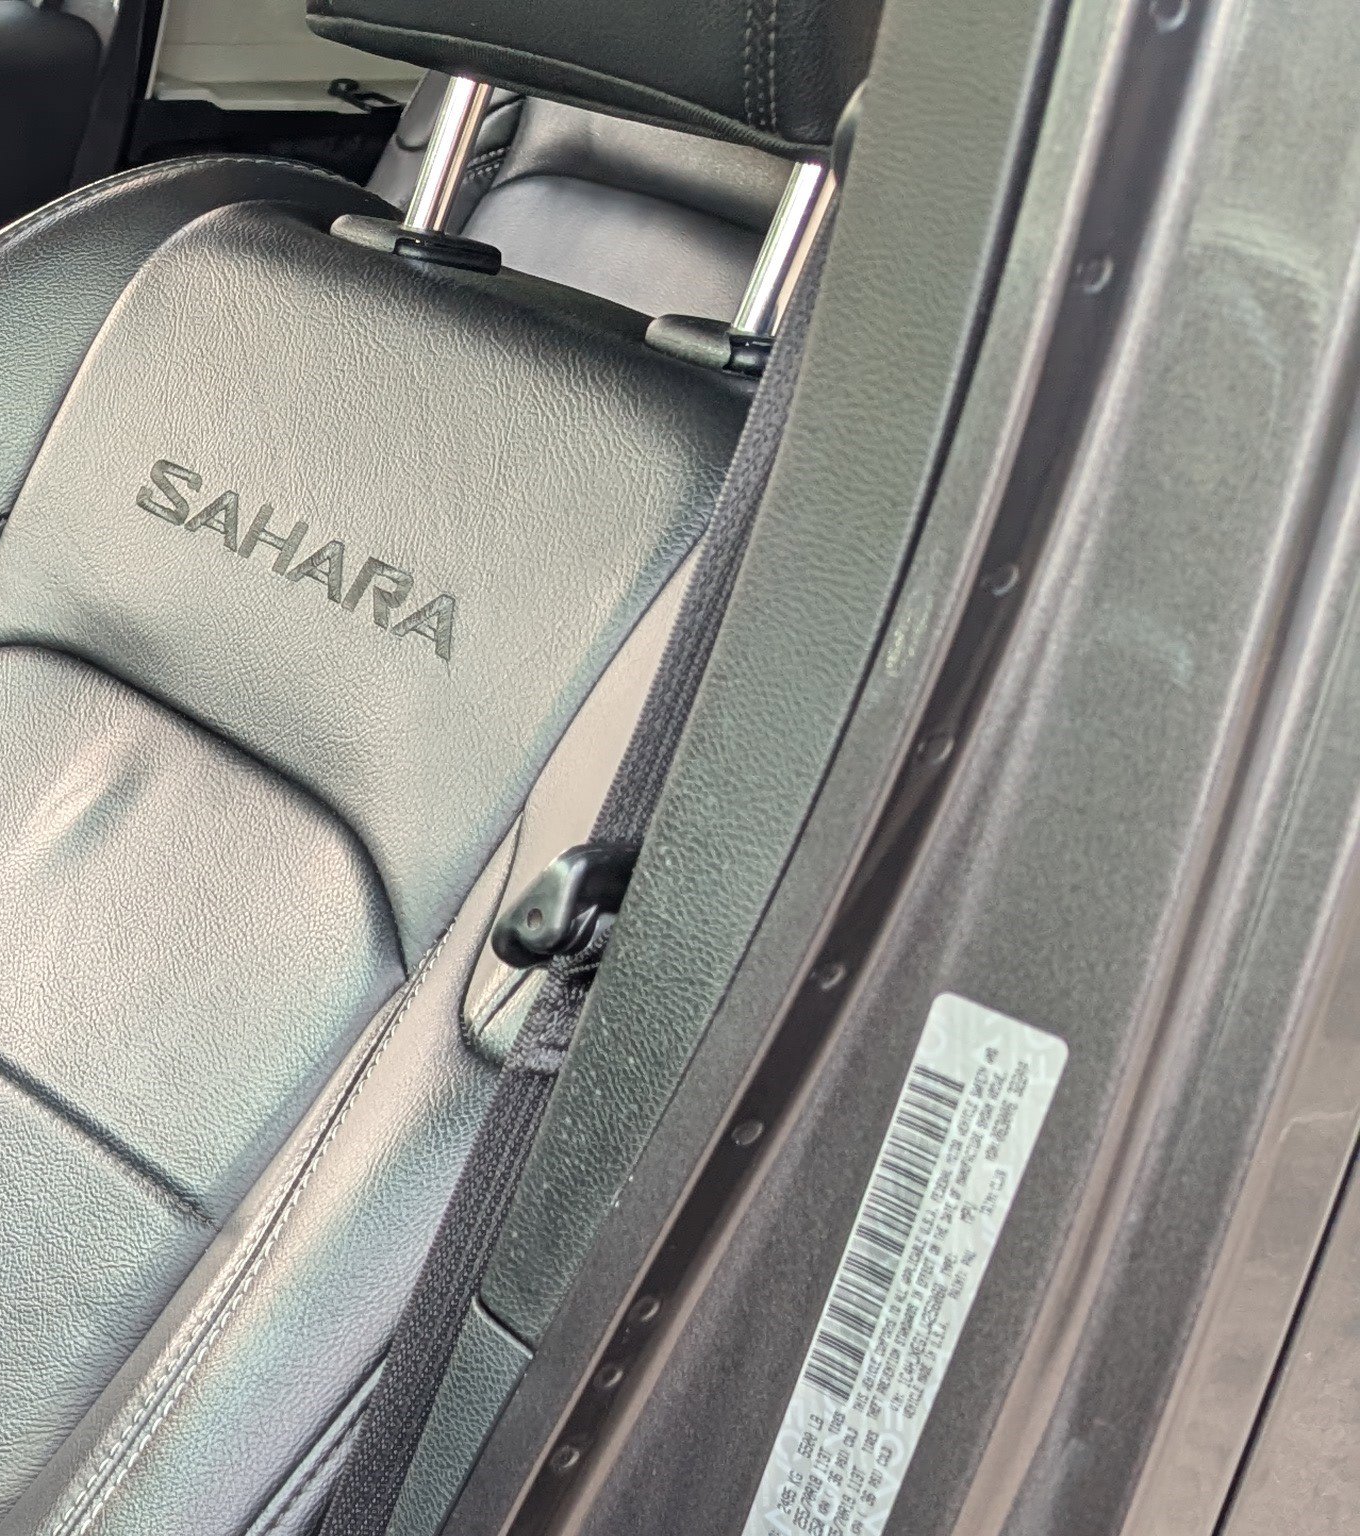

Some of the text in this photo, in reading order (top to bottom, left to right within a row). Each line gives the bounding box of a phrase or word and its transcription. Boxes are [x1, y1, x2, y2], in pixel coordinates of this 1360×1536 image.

[136, 457, 457, 664] SAHARA
[786, 1468, 804, 1487] KG
[806, 1412, 824, 1431] LB
